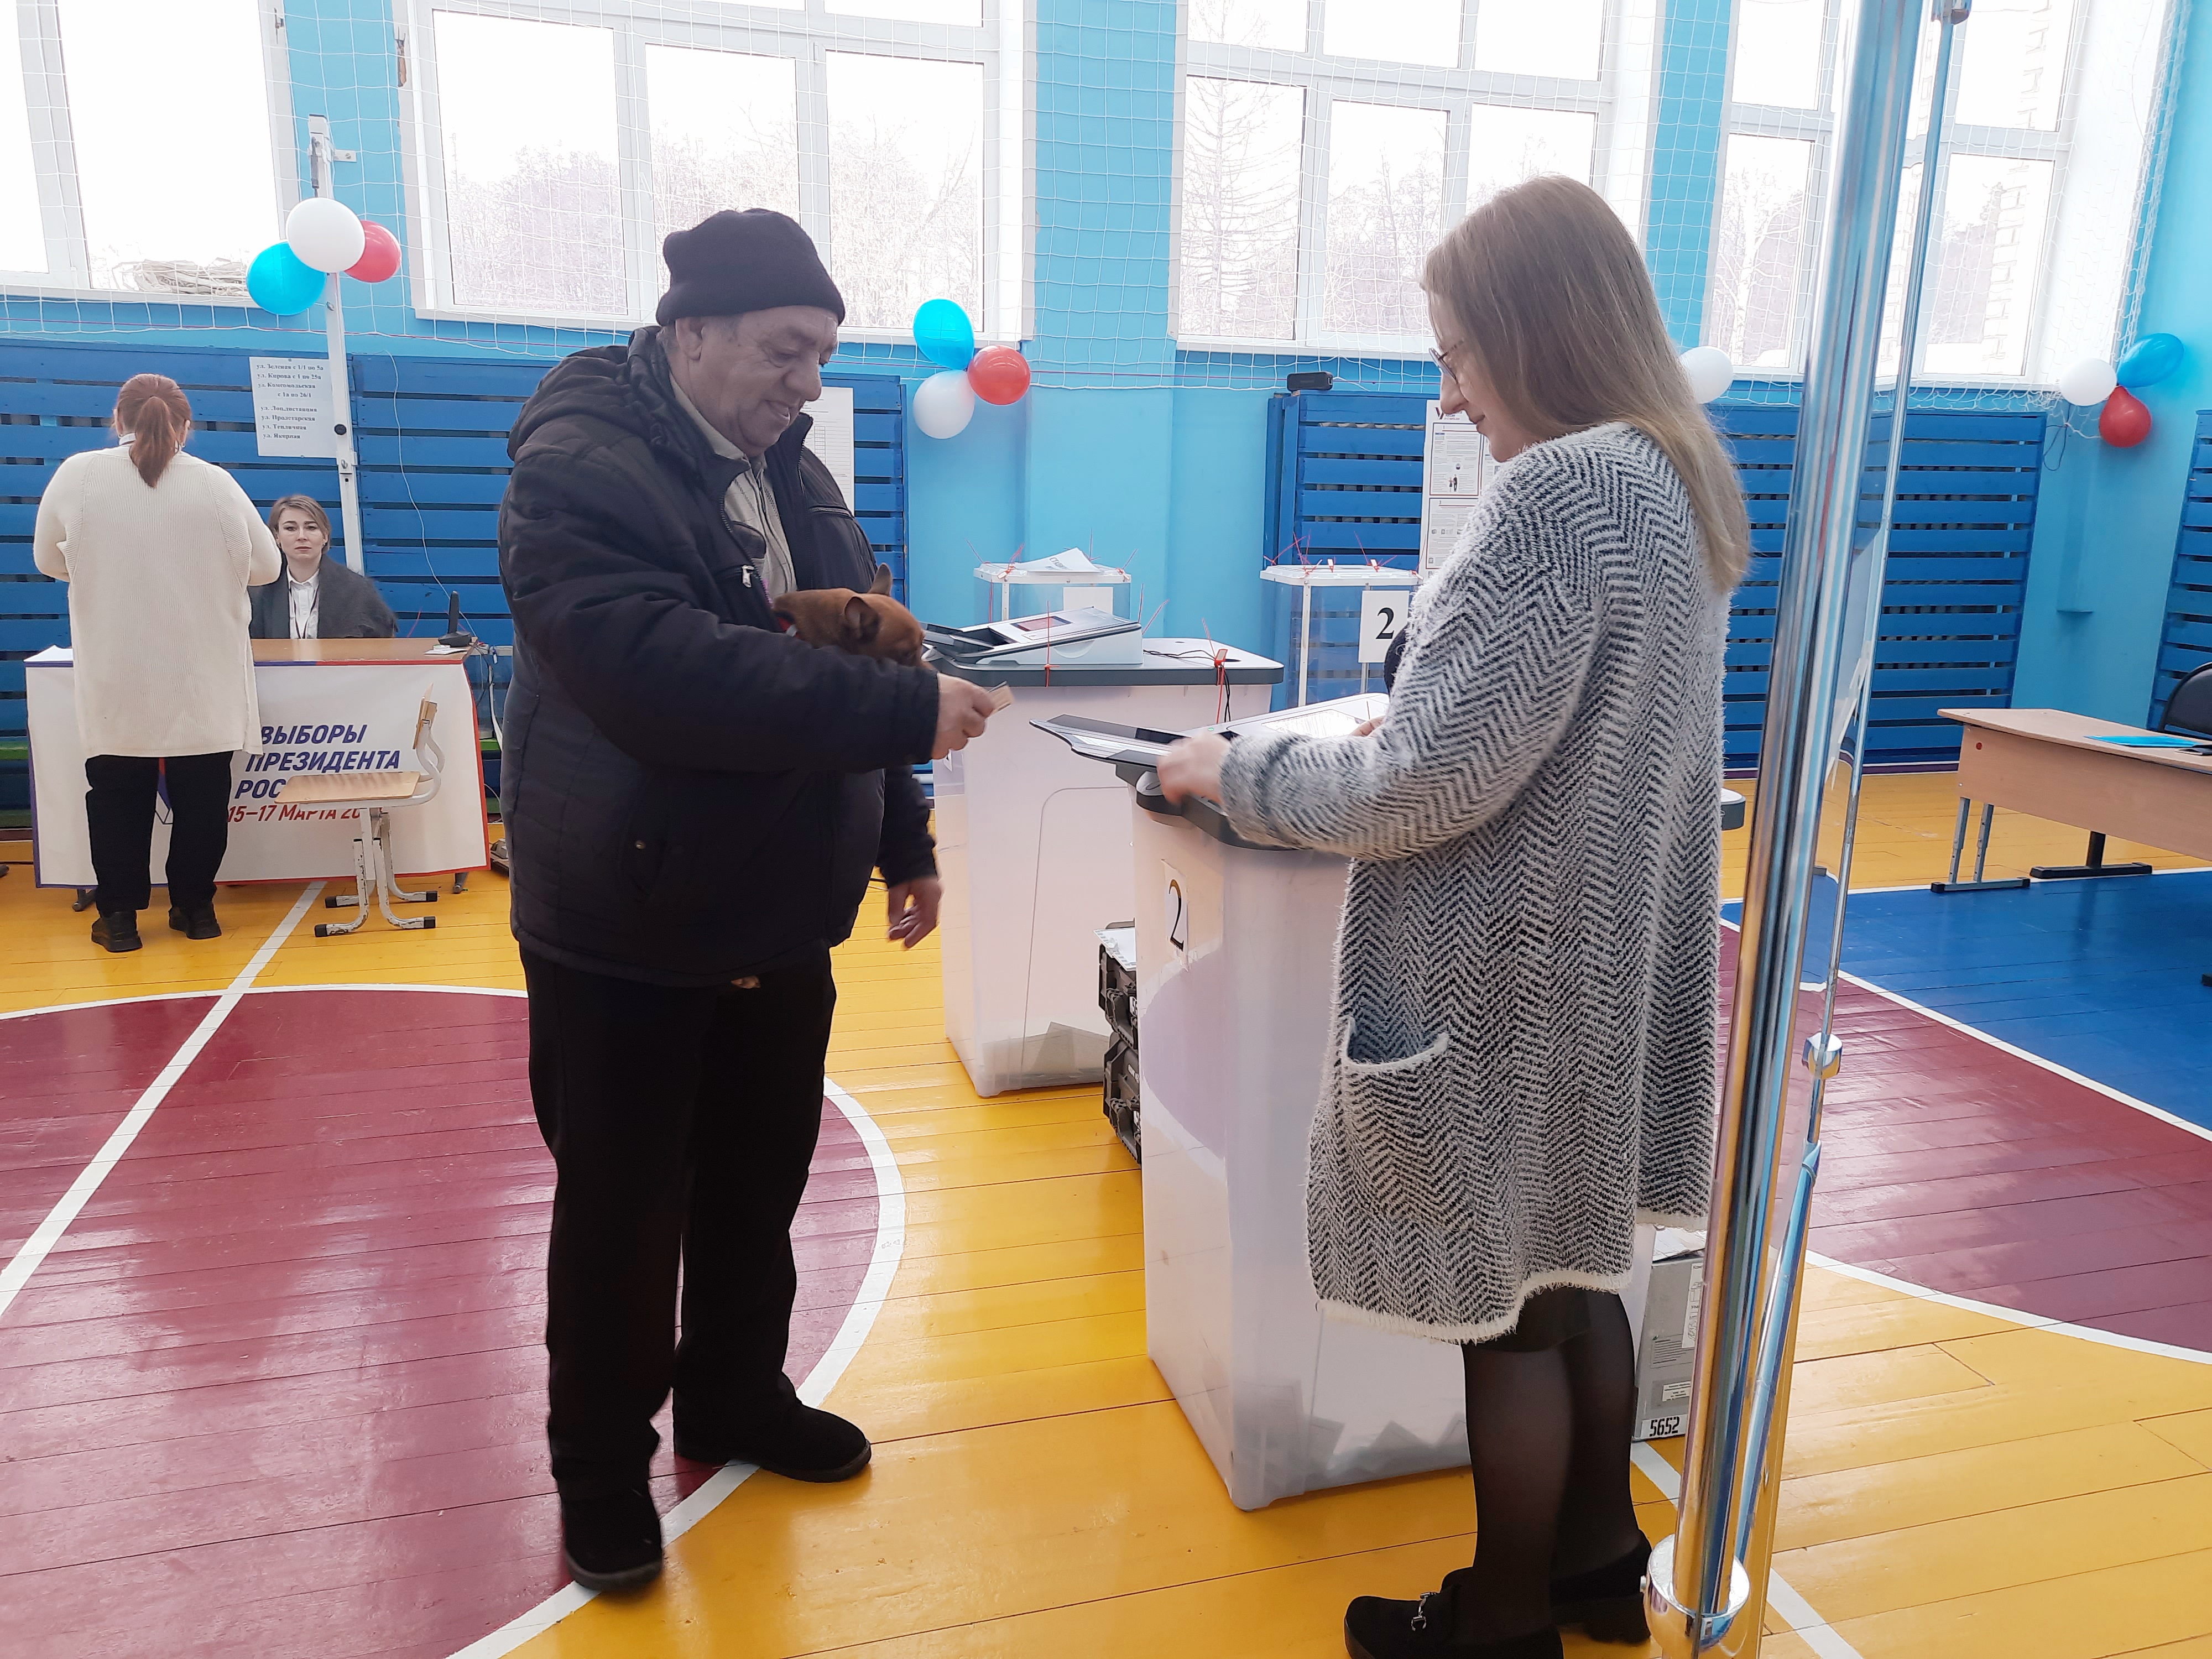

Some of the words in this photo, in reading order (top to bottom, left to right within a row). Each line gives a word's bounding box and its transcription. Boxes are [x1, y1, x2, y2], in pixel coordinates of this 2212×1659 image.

[1375, 607, 1395, 639] 2
[262, 724, 368, 745] ВЫБОРЫ
[245, 750, 401, 774] ПРЕЗИДЕНТА
[234, 779, 286, 799] РОС
[1168, 879, 1184, 952] 2
[1649, 1416, 1680, 1437] 5652
